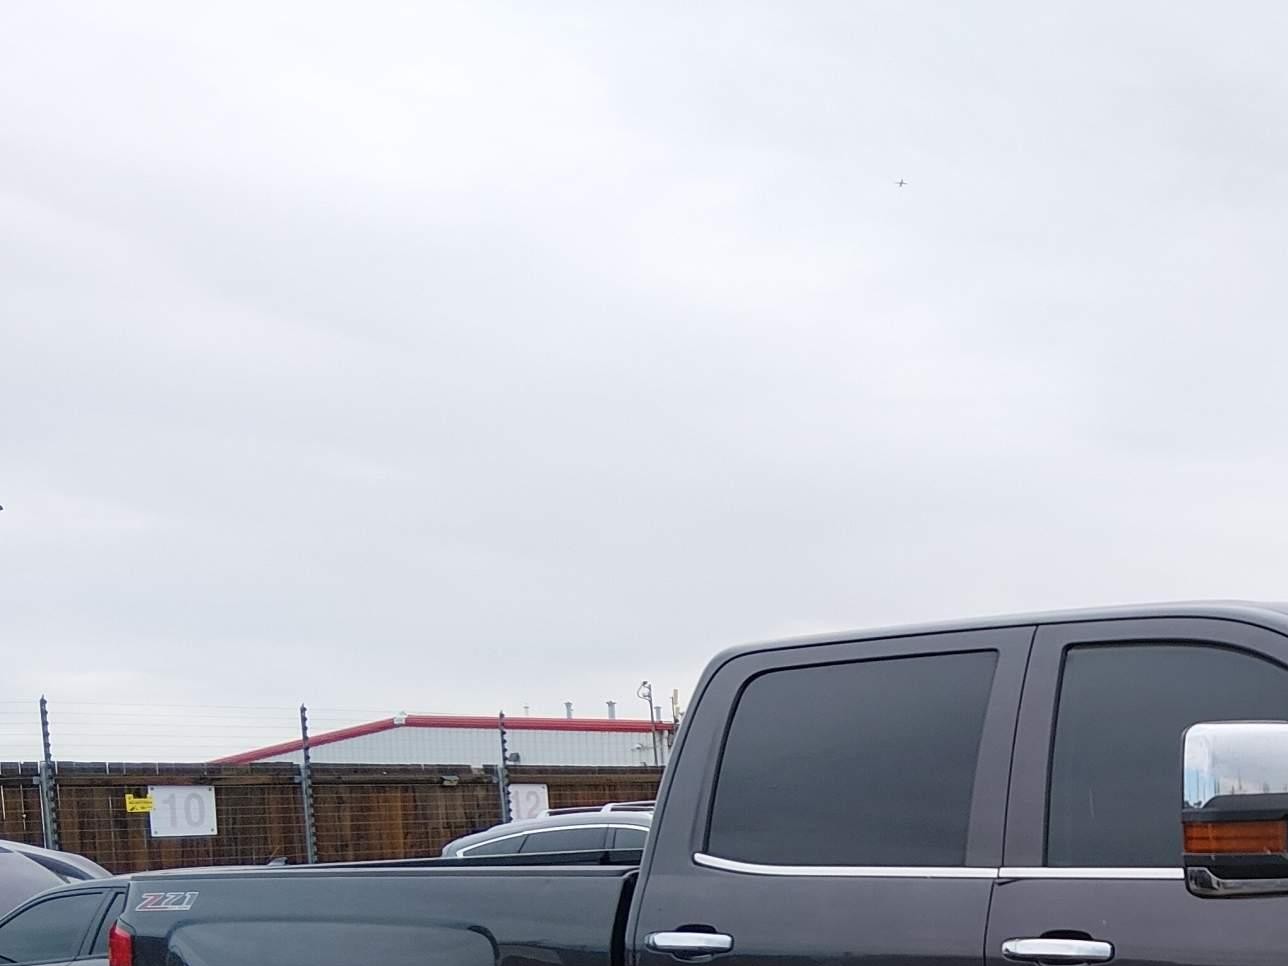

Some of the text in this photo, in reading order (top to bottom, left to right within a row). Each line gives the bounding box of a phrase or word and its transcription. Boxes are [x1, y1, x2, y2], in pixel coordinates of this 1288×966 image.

[162, 792, 206, 828] 10
[512, 790, 541, 819] 12
[136, 891, 199, 911] Z71
